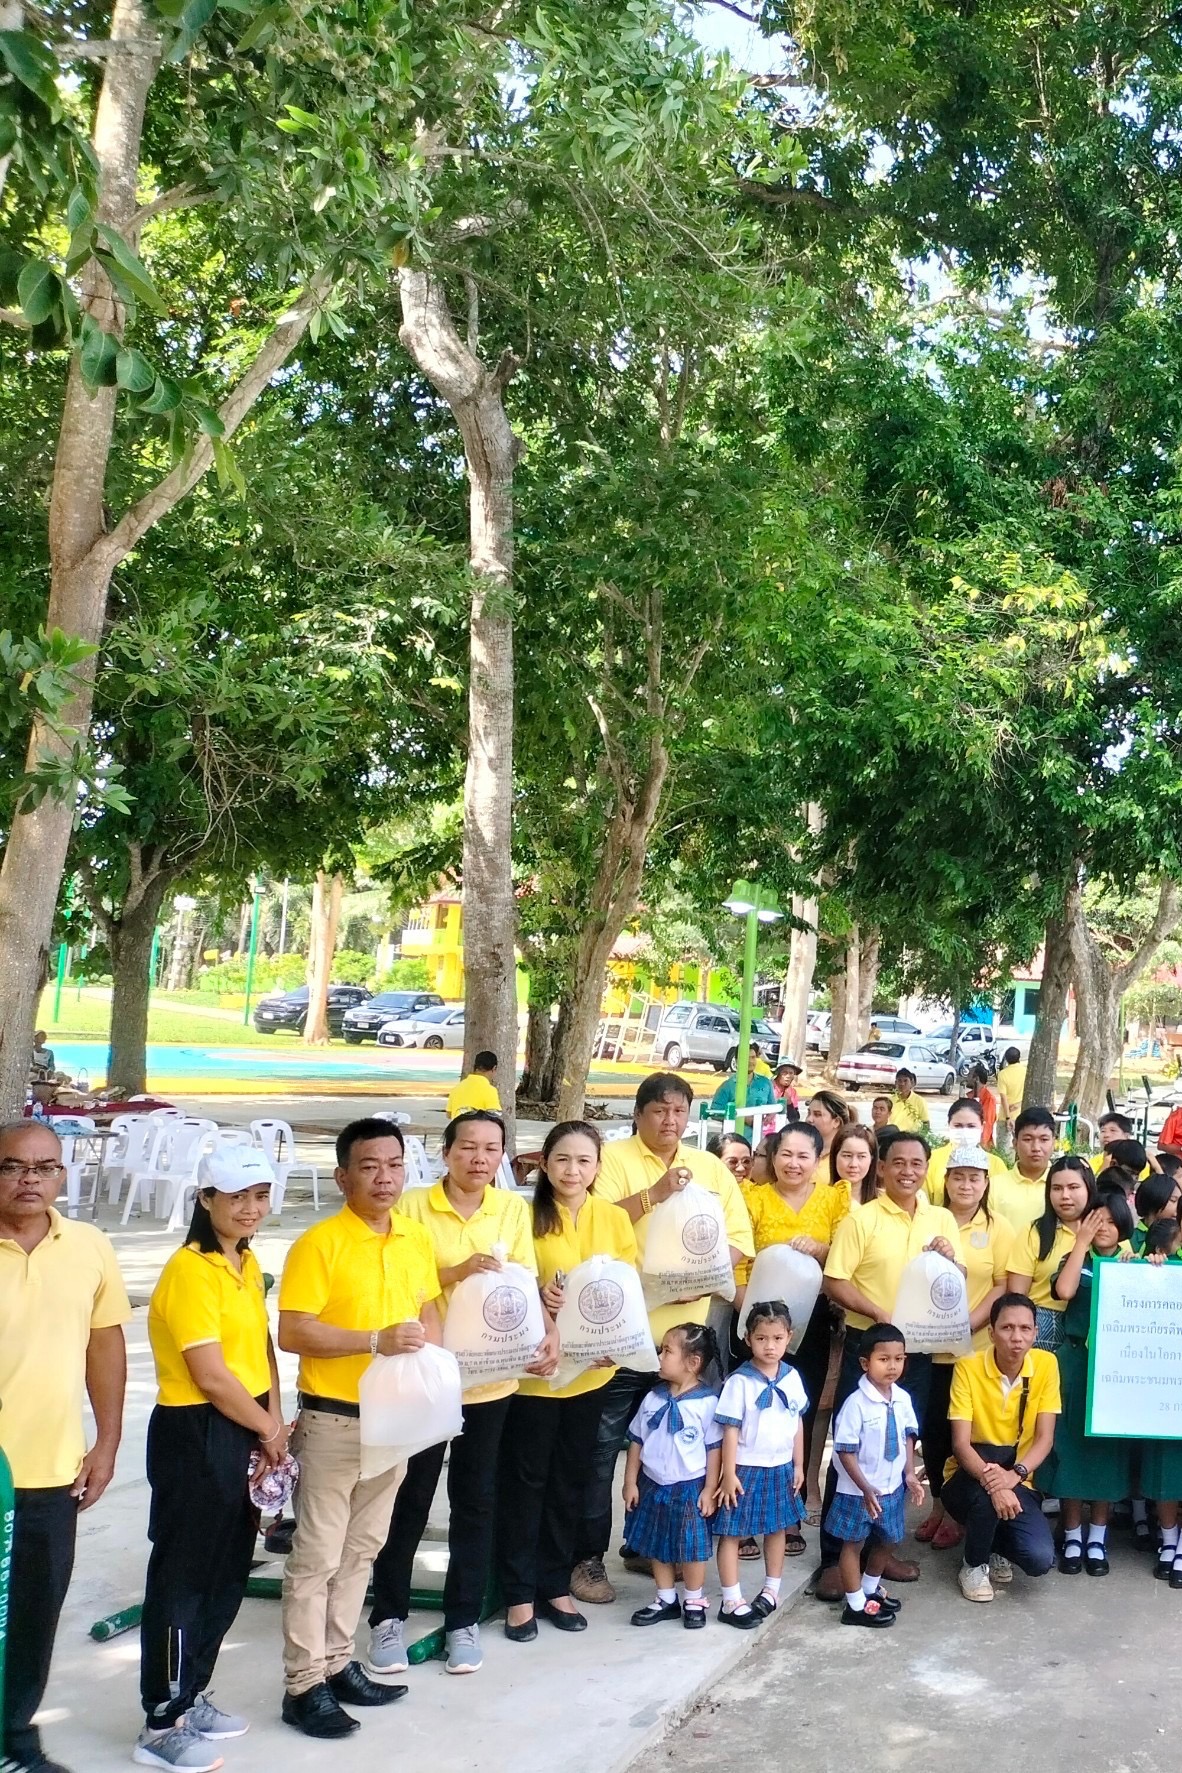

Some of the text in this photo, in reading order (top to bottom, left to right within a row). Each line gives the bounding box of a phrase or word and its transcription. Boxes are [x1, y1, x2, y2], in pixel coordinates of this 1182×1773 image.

[680, 1249, 720, 1265] กรมประมง
[926, 1307, 961, 1320] กรมประมง
[481, 1326, 530, 1343] กรมประมง
[579, 1318, 626, 1335] กรมประมง
[1159, 1402, 1171, 1412] 28
